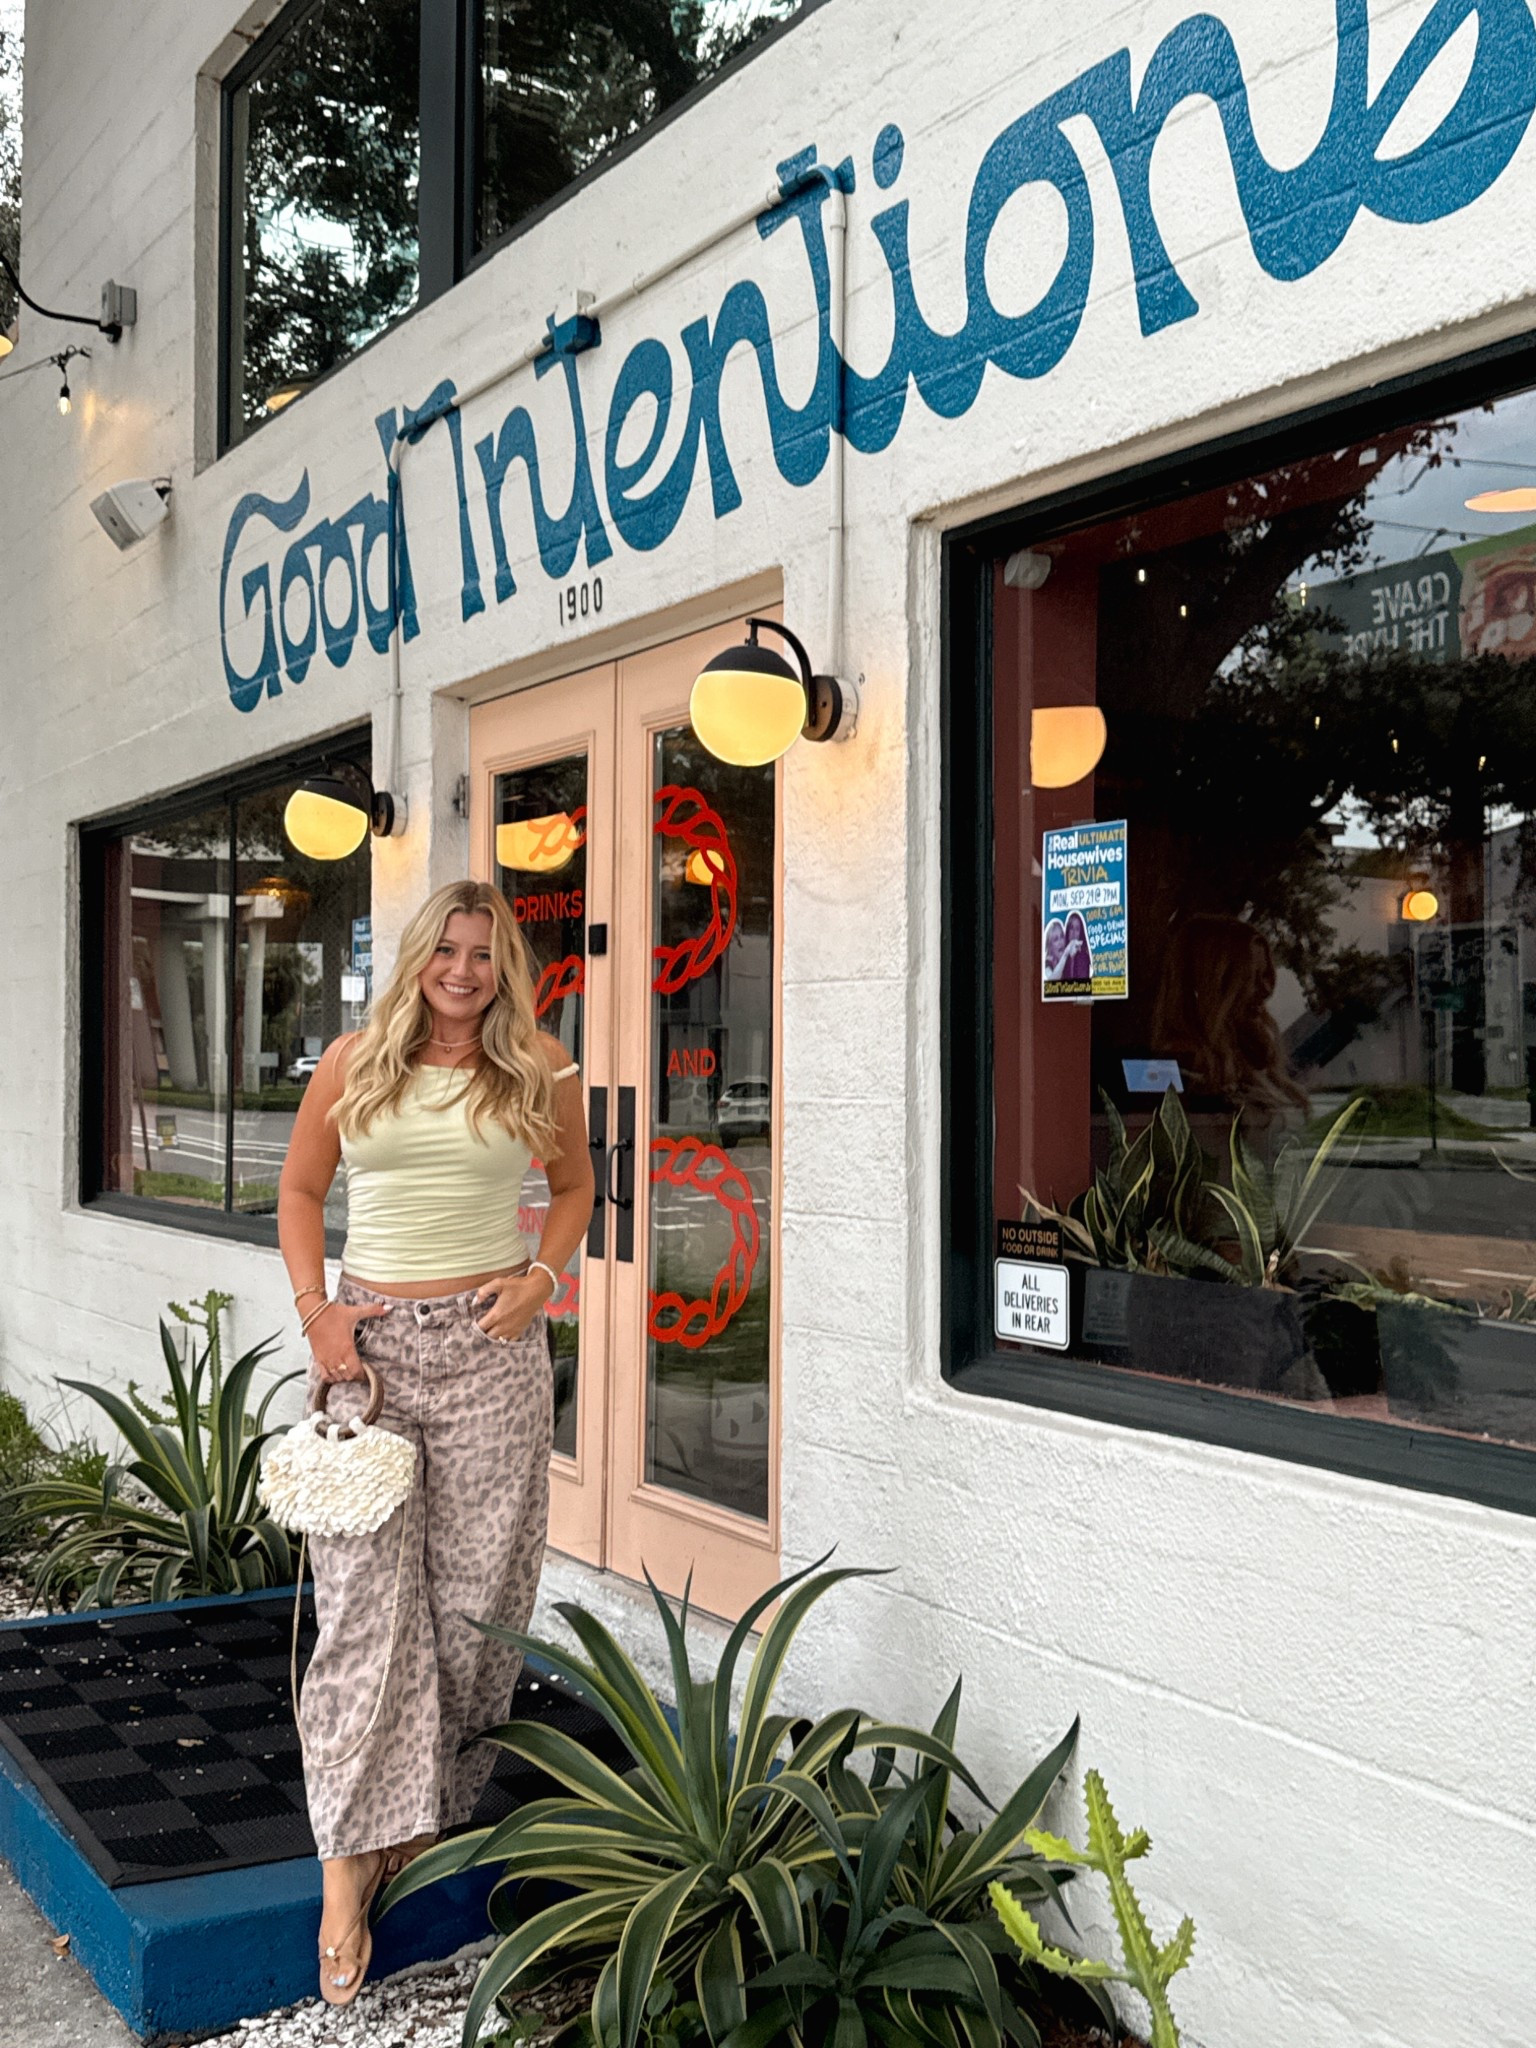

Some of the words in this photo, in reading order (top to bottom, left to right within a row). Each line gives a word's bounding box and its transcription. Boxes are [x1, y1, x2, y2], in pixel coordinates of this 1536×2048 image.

[221, 405, 421, 713] Good
[559, 577, 603, 626] 1900
[1053, 831, 1079, 852] Real
[1080, 828, 1125, 846] ULTIMATE
[1047, 845, 1123, 870] Housewives
[1061, 865, 1109, 887] TRIVIA
[513, 889, 582, 924] DRINKS
[667, 1048, 716, 1078] AND
[1002, 1227, 1016, 1240] NO
[1018, 1230, 1058, 1244] OUTSIDE
[1002, 1243, 1022, 1254] FOOD
[1024, 1243, 1034, 1254] OR
[1036, 1246, 1058, 1257] DRINK
[1022, 1273, 1040, 1291] ALL
[1004, 1290, 1058, 1315] DELIVERIES
[1011, 1312, 1021, 1328] IN
[1025, 1313, 1050, 1334] REAR
